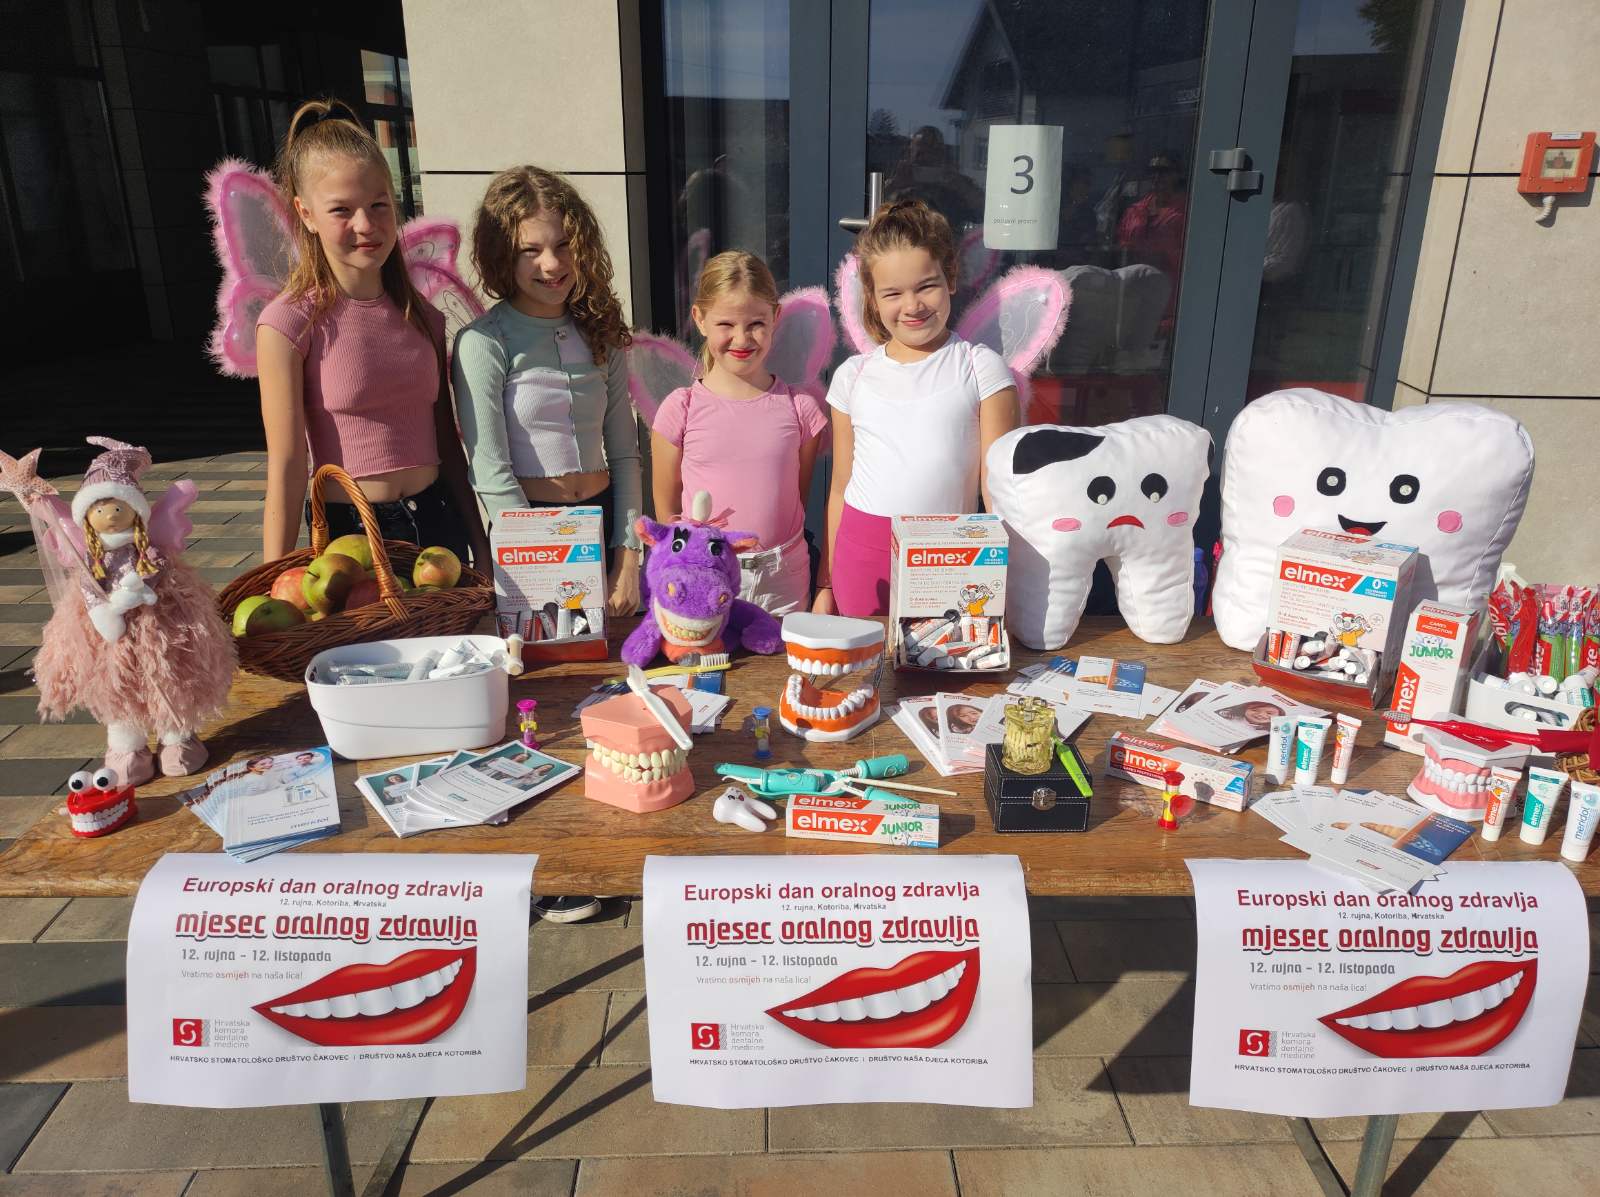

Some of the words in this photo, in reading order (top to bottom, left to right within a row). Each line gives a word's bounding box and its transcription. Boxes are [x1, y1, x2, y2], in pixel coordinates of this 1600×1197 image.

[1010, 154, 1034, 195] 3
[502, 548, 560, 563] elmex
[911, 550, 968, 565] elmex
[1284, 565, 1347, 589] elmex
[1409, 645, 1454, 659] JUNIOR
[1393, 675, 1417, 731] emex
[1121, 736, 1165, 750] elmex
[1280, 735, 1288, 766] meridol
[1115, 749, 1168, 772] elmex
[798, 796, 858, 809] elmex
[883, 803, 921, 811] JUNIOR
[1489, 802, 1499, 825] elmex
[1530, 803, 1541, 826] elmex
[797, 812, 868, 833] elmex
[881, 821, 923, 835] JUNIOR
[1575, 806, 1590, 840] meridol
[183, 878, 274, 896] Europski
[280, 879, 316, 894] dan
[323, 879, 400, 899] oralnog
[405, 880, 483, 901] zdravlja
[685, 883, 772, 904] Europski
[779, 883, 814, 899] dan
[821, 882, 896, 901] oralnog
[903, 882, 980, 901] zdravlja
[280, 898, 290, 906] 12.
[292, 899, 314, 908] rujna,
[317, 899, 351, 908] Kotoriba,
[353, 900, 387, 908] Hrvatska
[794, 904, 816, 912] rujna,
[817, 903, 852, 911] Kotoriba,
[1237, 889, 1327, 910] Europski
[1333, 890, 1370, 907] dan
[1377, 893, 1453, 912] oralnog
[1459, 892, 1538, 912] zdravlja
[1351, 912, 1373, 920] rujna,
[1375, 912, 1410, 920] Kotoriba,
[1411, 912, 1445, 920] Hrvatska
[176, 911, 267, 939] mjesec
[275, 913, 370, 941] oralnog
[379, 915, 478, 942] zdravlja
[687, 918, 775, 945] mjesec
[781, 917, 873, 944] oralnog
[882, 915, 980, 943] zdravlja
[1242, 925, 1331, 952] mjesec
[1338, 926, 1432, 954] oralnog
[1440, 926, 1538, 955] zdravlja
[182, 949, 199, 961] 12.
[204, 949, 236, 962] rujna
[252, 950, 270, 961] 12.
[274, 950, 332, 964] listopada
[696, 956, 713, 966] 12.
[716, 956, 747, 968] rujna
[762, 955, 779, 966] 12.
[783, 955, 838, 968] listopada
[181, 970, 214, 979] Vratimo
[215, 970, 250, 981] osmijeh
[264, 970, 284, 979] naša
[286, 970, 303, 980] lica!
[1250, 962, 1267, 973] 12.
[1271, 962, 1302, 975] rujna
[1318, 962, 1335, 974] 12.
[1339, 963, 1395, 976] listopada
[696, 976, 727, 984] Vratimo
[728, 976, 760, 986] osmijeh
[774, 976, 793, 984] naša
[795, 976, 811, 984] lica!
[1250, 983, 1281, 991] Vratimo
[1283, 983, 1315, 993] osmijeh
[1329, 983, 1349, 991] naša
[1351, 983, 1368, 992] lica!
[214, 1019, 250, 1027] Hrvatska
[170, 1055, 209, 1063] HRVATSKO
[211, 1055, 273, 1064] STOMATOLOŠKO
[276, 1055, 311, 1063] DRUŠTVO
[313, 1053, 349, 1061] ČAKOVEC
[359, 1052, 395, 1060] DRUŠTVO
[396, 1051, 417, 1059] NAŠA
[729, 1058, 788, 1066] STOMATOLOŠKO
[789, 1057, 823, 1065] DRUŠTVO
[868, 1054, 902, 1062] DRUŠTVO
[903, 1054, 924, 1062] NAŠA
[925, 1056, 949, 1064] DJECA
[950, 1057, 988, 1065] KOTORIBA
[1234, 1064, 1275, 1073] HRVATSKO
[1277, 1066, 1336, 1075] STOMATOLOŠKO
[1338, 1066, 1371, 1074] DRUŠTVO
[1372, 1064, 1407, 1073] ČAKOVEC
[1415, 1063, 1448, 1072] DRUŠTVO
[1450, 1063, 1469, 1071] NAŠA
[1470, 1063, 1494, 1071] DJECA
[1494, 1062, 1531, 1070] KOTORIBA
